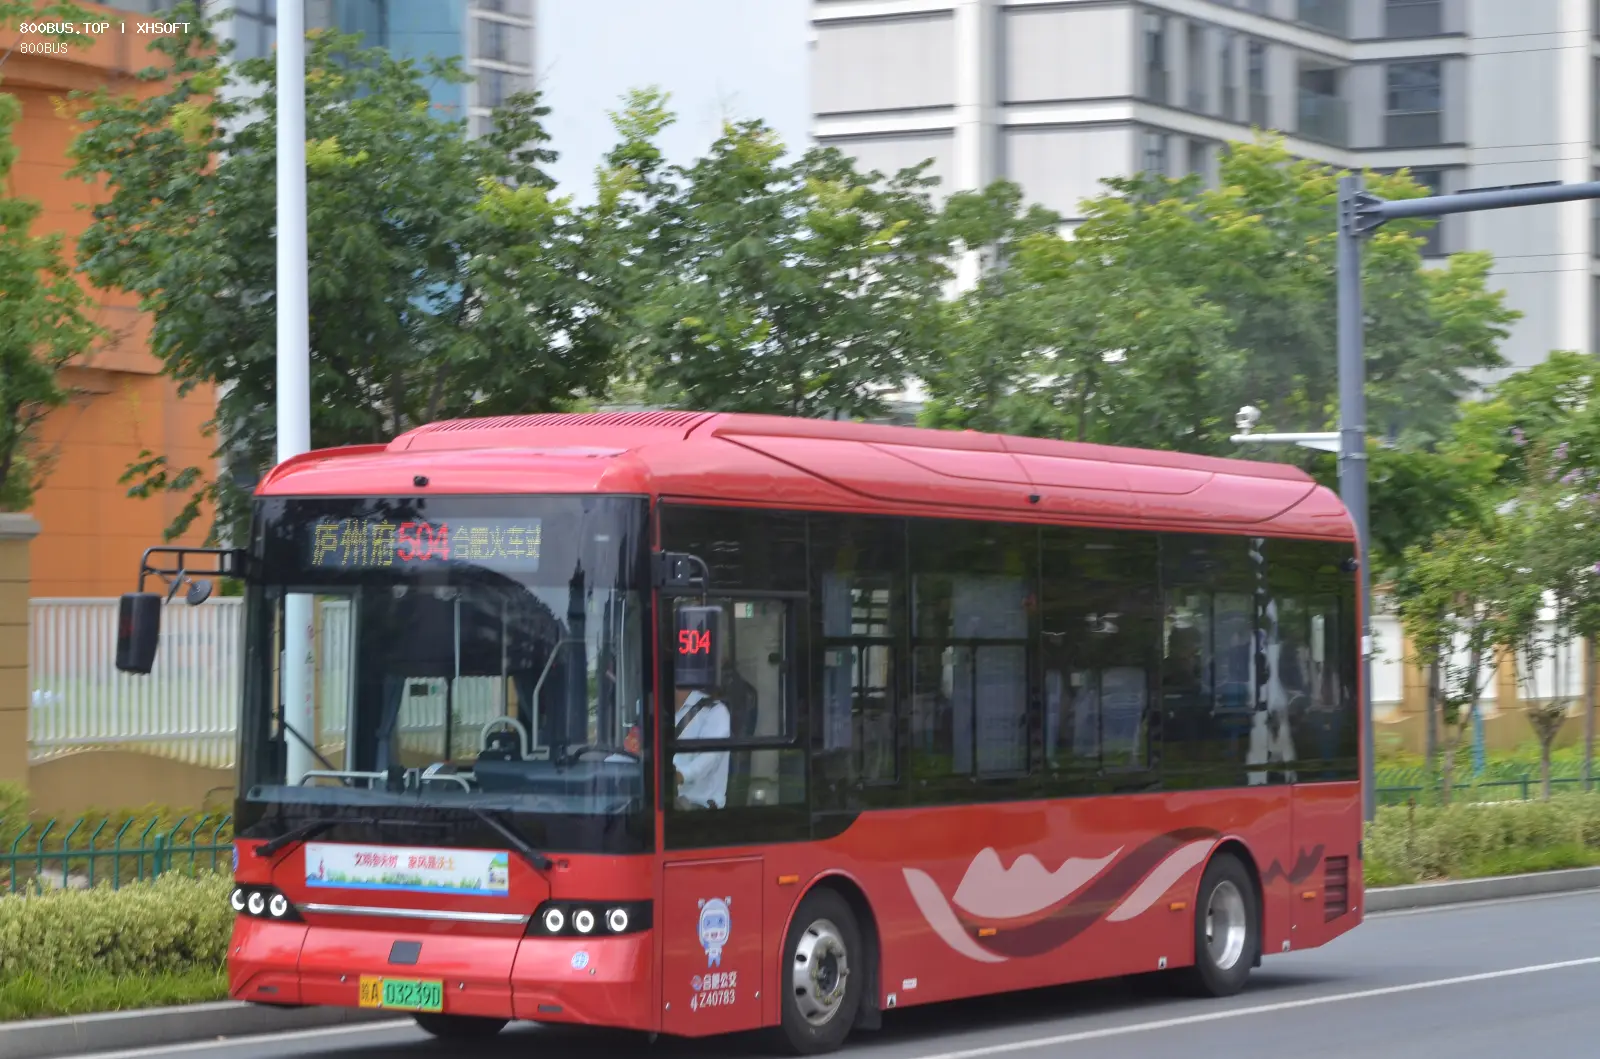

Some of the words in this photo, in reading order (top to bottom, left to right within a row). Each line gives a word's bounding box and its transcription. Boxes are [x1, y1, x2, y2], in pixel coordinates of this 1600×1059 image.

[312, 519, 396, 566] 庐州府
[397, 521, 451, 561] 504
[452, 524, 542, 560] 合肥火车站
[678, 629, 711, 654] 504
[703, 970, 737, 991] 合肥公交
[699, 989, 736, 1008] Z40783
